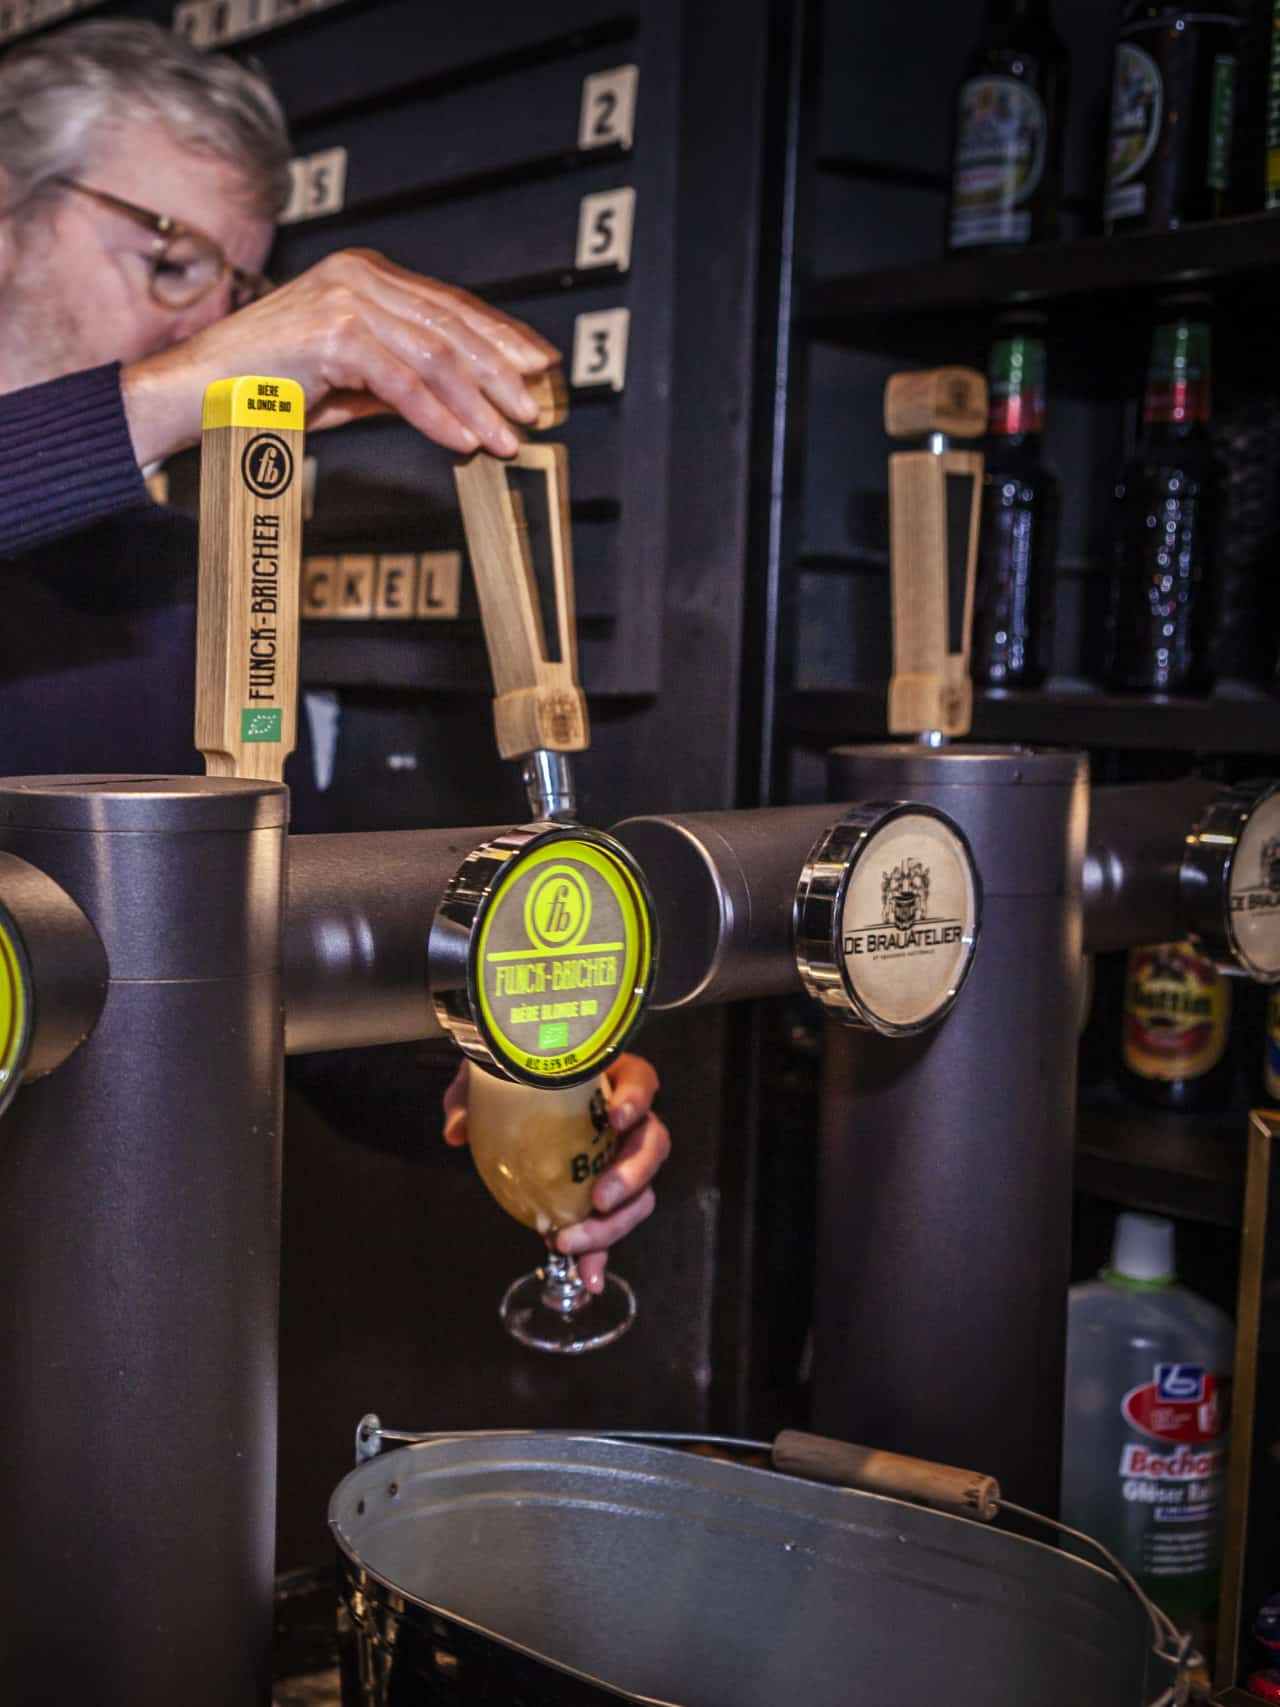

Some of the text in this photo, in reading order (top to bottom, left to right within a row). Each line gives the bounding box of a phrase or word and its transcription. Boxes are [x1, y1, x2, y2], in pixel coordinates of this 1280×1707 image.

[593, 90, 617, 135] 2
[591, 208, 615, 255] 5
[587, 331, 609, 374] 3
[247, 398, 292, 413] BLONDE BIO
[257, 383, 279, 397] BIÈRE
[249, 513, 280, 701] FUNCK-BRICHER
[844, 926, 962, 954] DE BRAUATELIER
